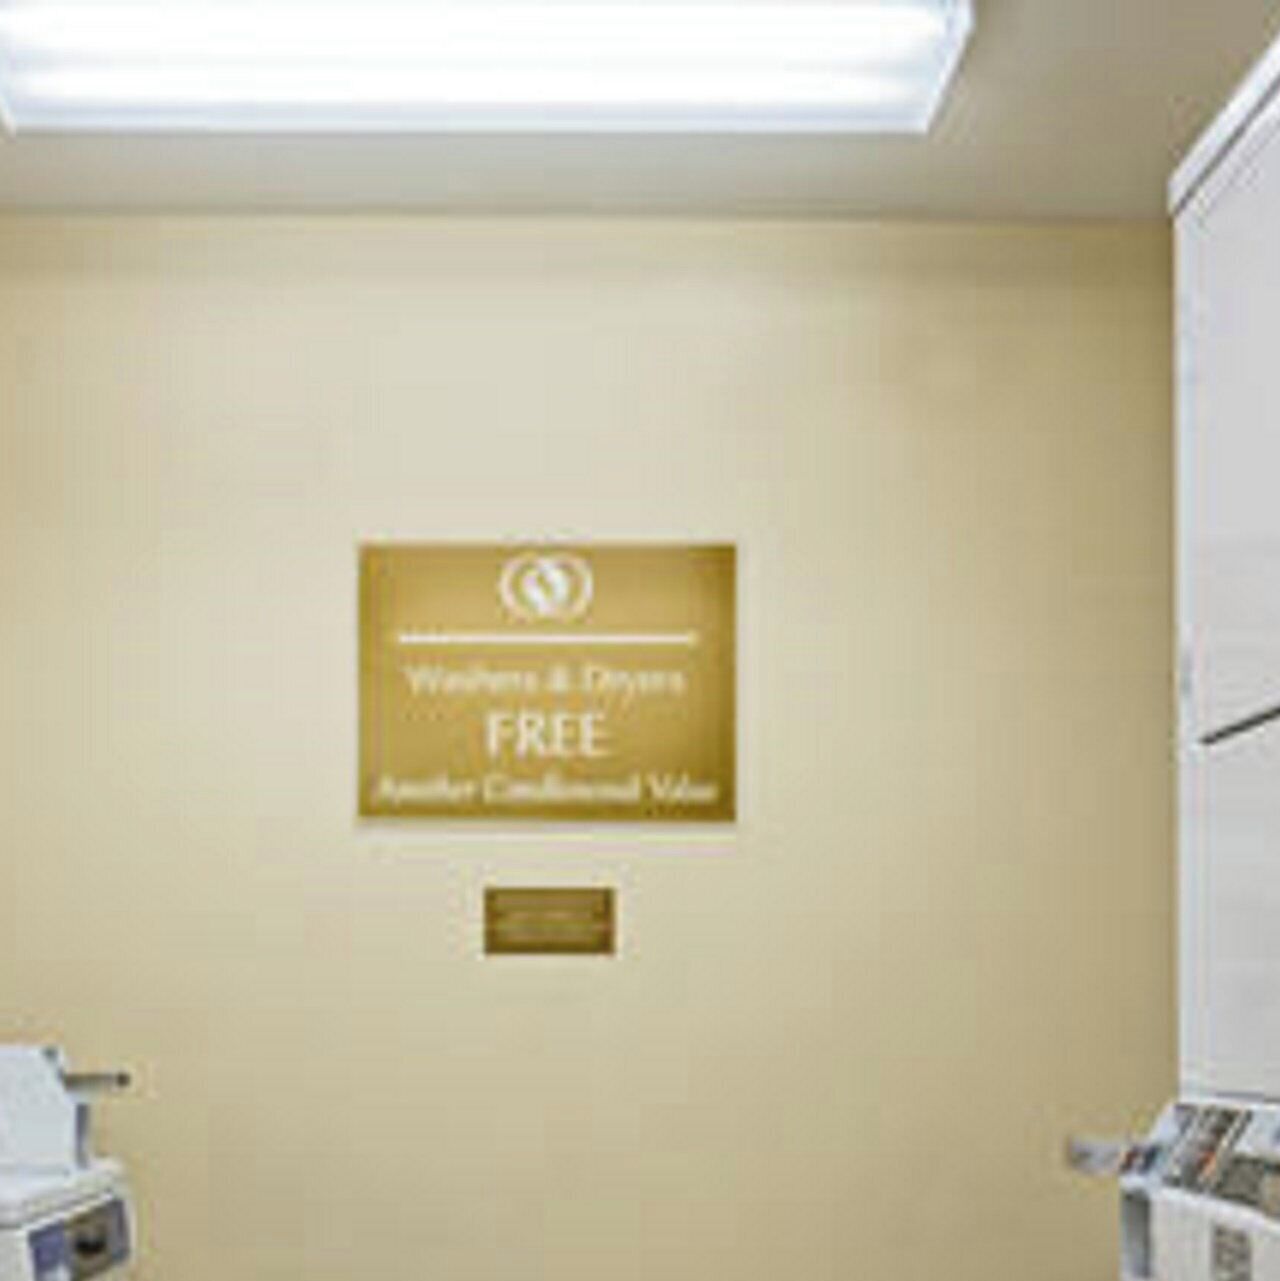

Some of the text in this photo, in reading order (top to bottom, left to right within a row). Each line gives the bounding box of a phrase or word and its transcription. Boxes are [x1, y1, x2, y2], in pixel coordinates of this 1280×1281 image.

[402, 666, 538, 696] Washers
[583, 665, 688, 708] Dryers
[486, 711, 610, 756] FREE
